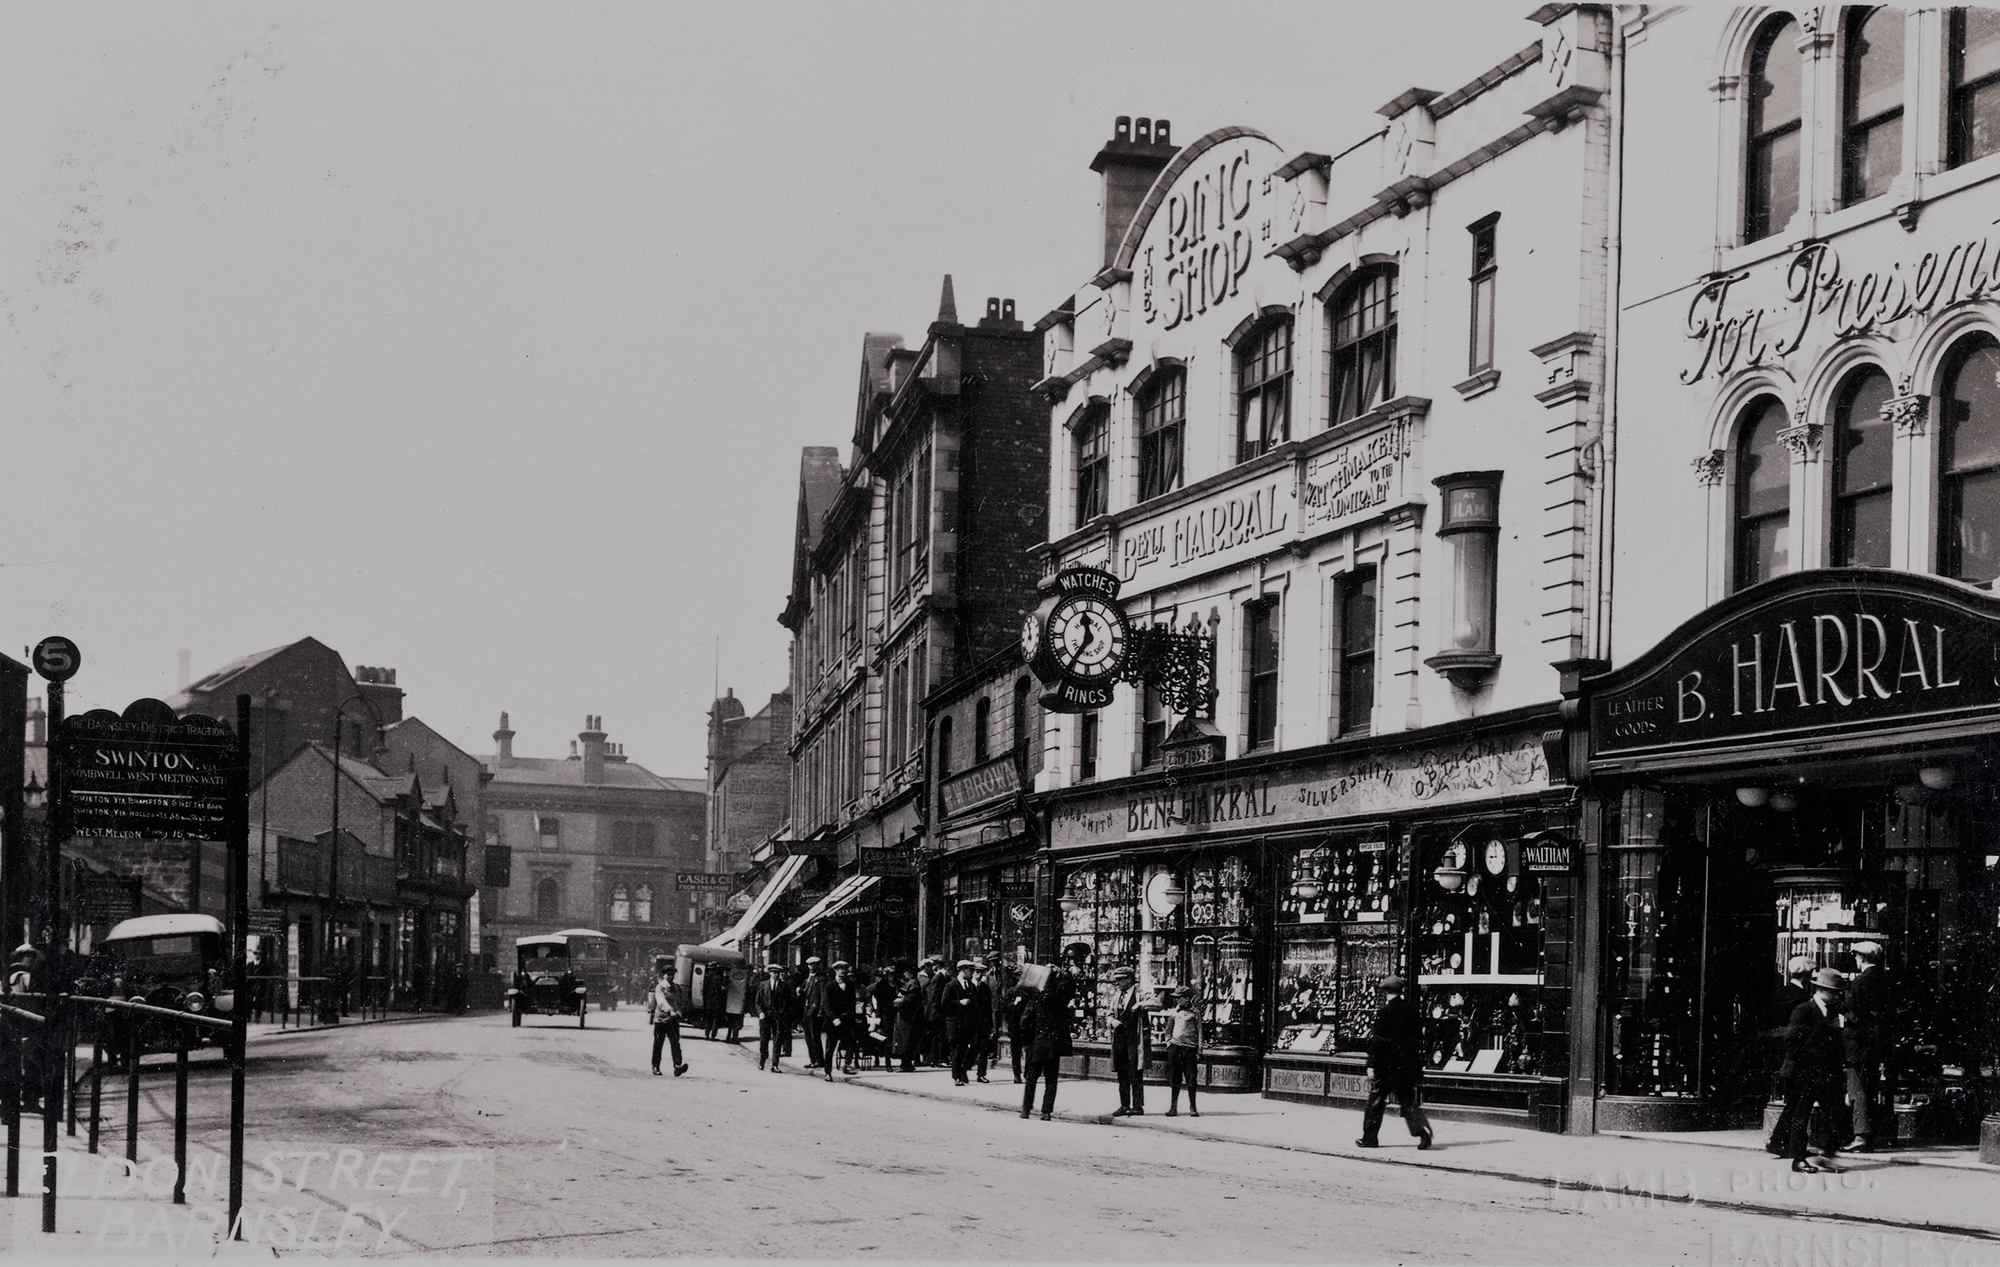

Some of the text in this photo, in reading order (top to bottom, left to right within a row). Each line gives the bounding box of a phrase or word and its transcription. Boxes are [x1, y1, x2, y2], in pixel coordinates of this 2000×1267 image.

[1164, 148, 1253, 263] RING
[1163, 228, 1253, 332] SHOP
[1169, 484, 1287, 568] HARRAL
[1060, 573, 1115, 594] WATCHES
[40, 642, 72, 672] 5
[1731, 613, 1961, 717] HARRAL
[1064, 684, 1107, 705] RINGS
[1608, 696, 1664, 716] LEATHER
[141, 722, 184, 735] DISTRICT
[186, 724, 225, 738] TRACTION
[1615, 721, 1657, 738] GOODS
[127, 772, 158, 783] WEST
[159, 773, 199, 784] MELTON
[1297, 762, 1394, 808] SILVERSMITH
[1526, 847, 1570, 864] WALTHAM
